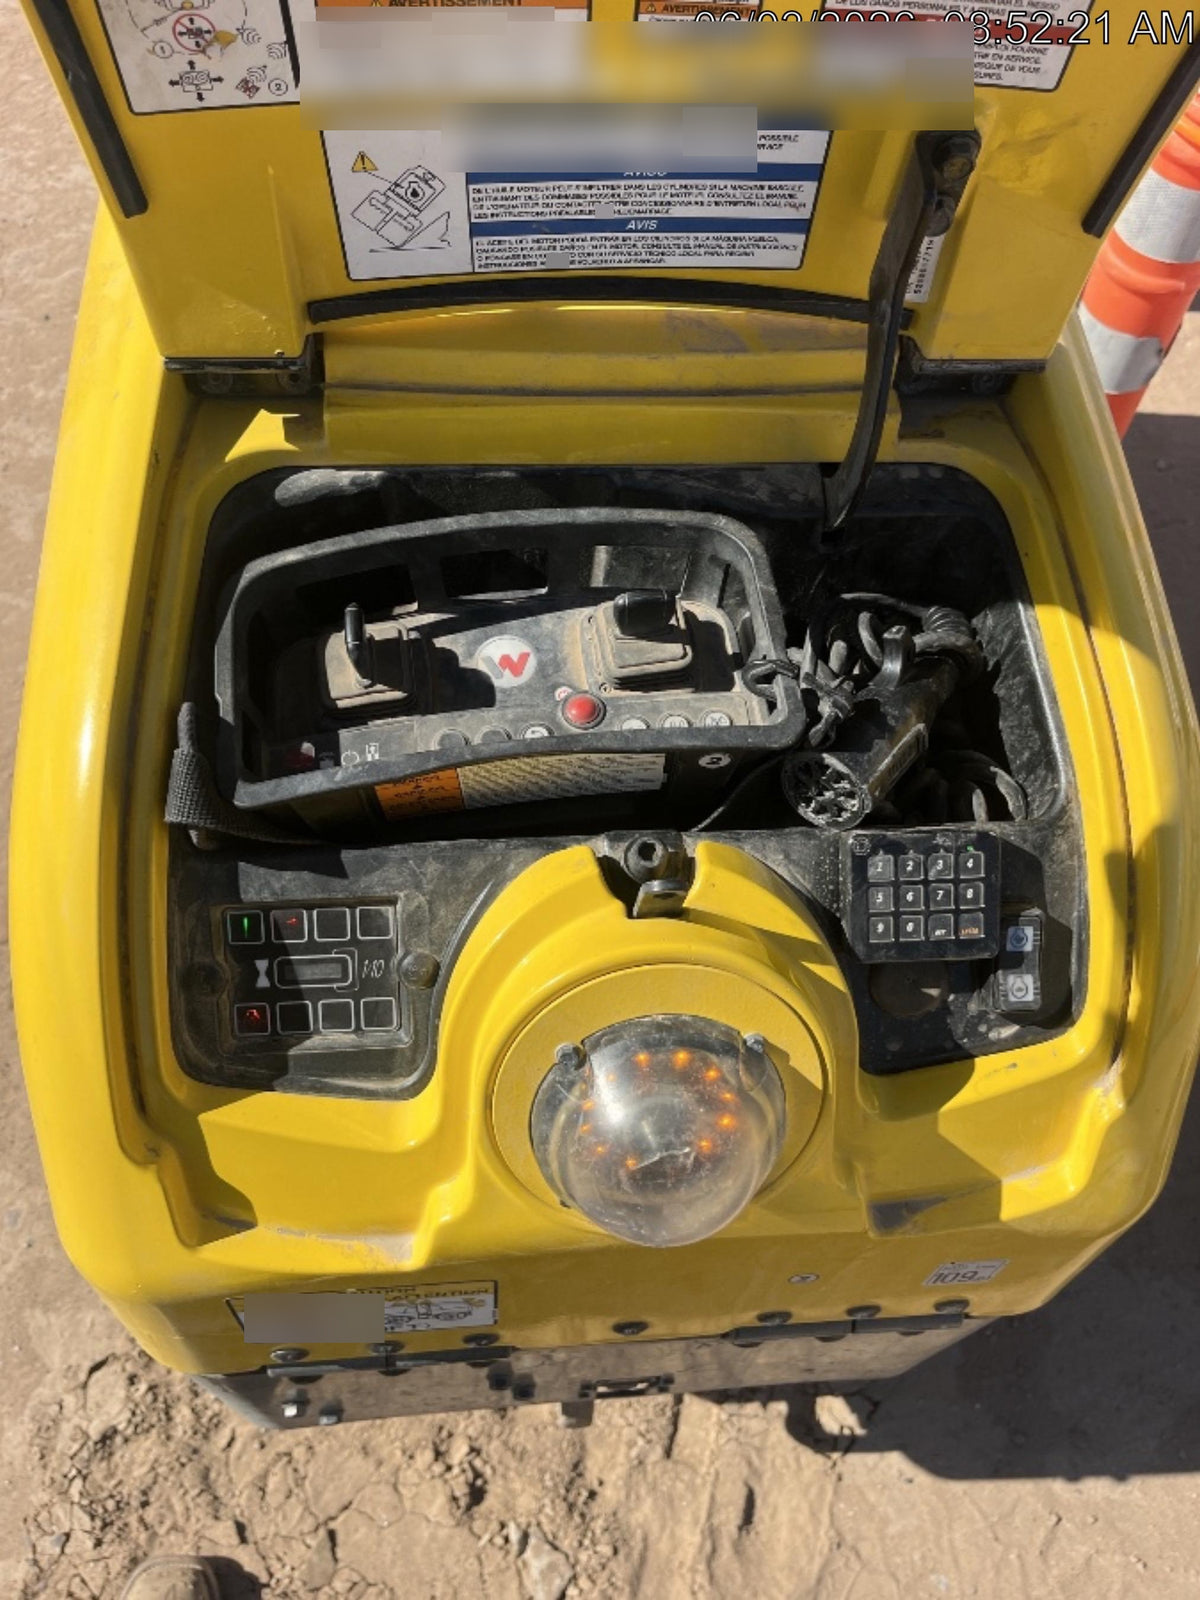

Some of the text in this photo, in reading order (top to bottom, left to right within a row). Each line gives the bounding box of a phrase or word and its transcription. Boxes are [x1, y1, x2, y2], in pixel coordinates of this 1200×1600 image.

[625, 220, 658, 231] AVIS
[876, 861, 883, 872] 1
[906, 860, 914, 871] 2
[936, 859, 943, 870] 3
[966, 858, 974, 869] 4
[876, 891, 883, 903] 5
[906, 891, 915, 902] 6
[936, 889, 944, 900] 7
[966, 888, 974, 899] 8
